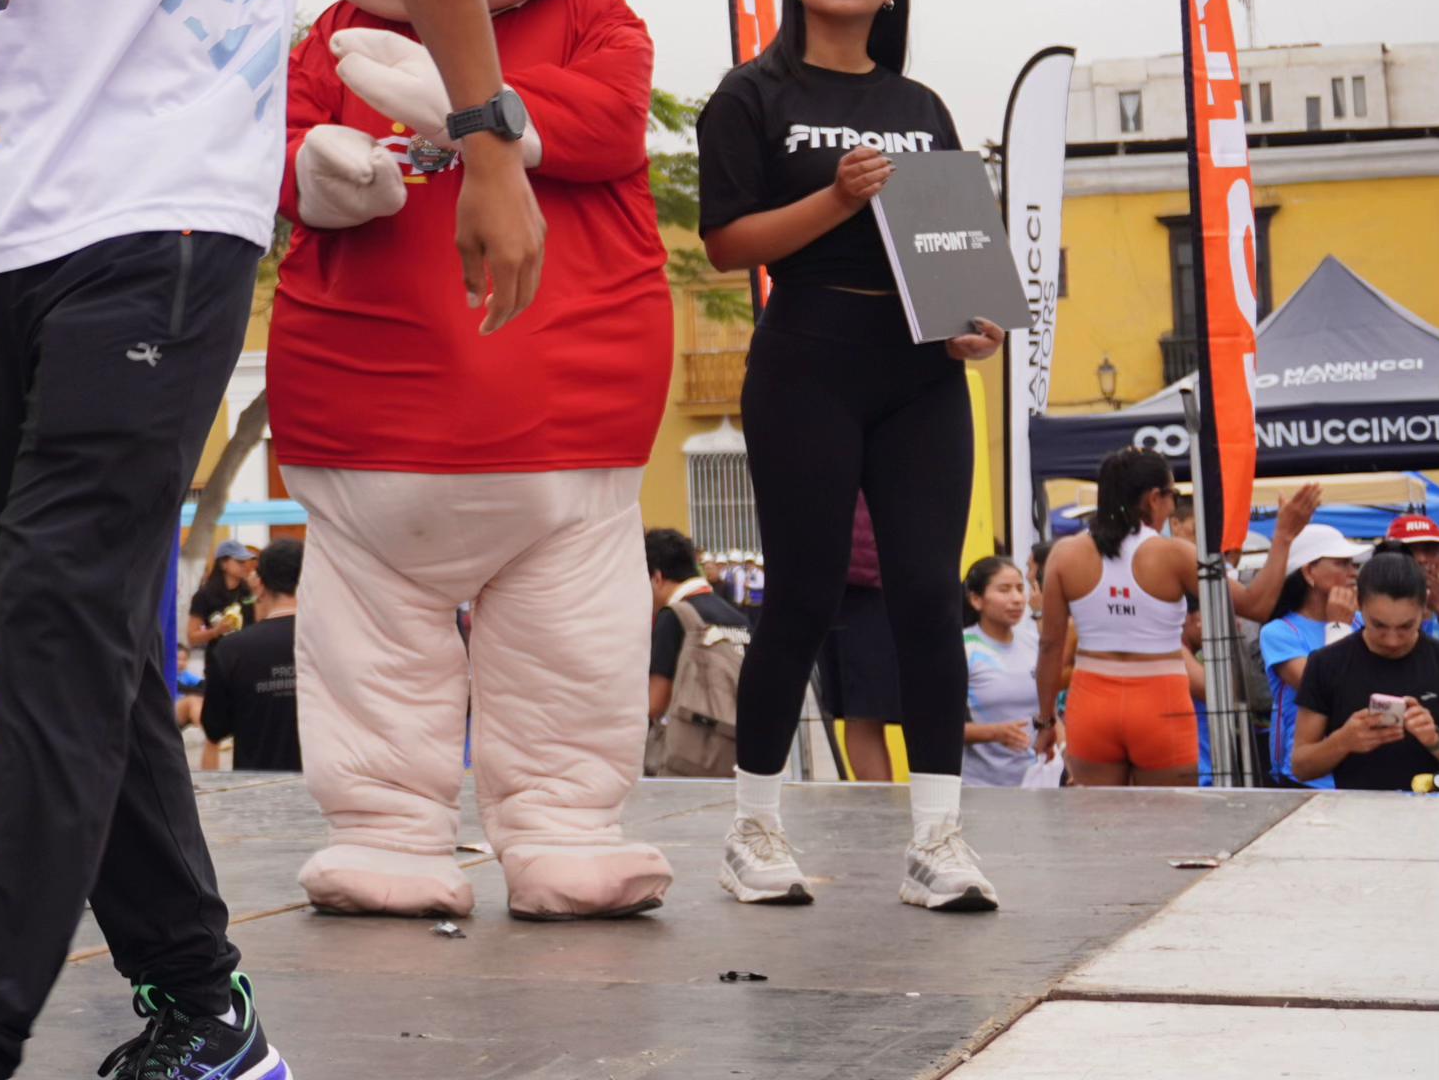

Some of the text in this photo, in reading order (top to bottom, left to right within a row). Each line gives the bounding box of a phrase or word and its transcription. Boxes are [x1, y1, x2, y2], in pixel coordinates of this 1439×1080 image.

[785, 124, 933, 153] FITPOINT
[914, 230, 968, 253] FITPOINT
[1283, 358, 1424, 379] MANNUCCI
[1406, 521, 1430, 531] RUN
[1107, 603, 1136, 616] YENI
